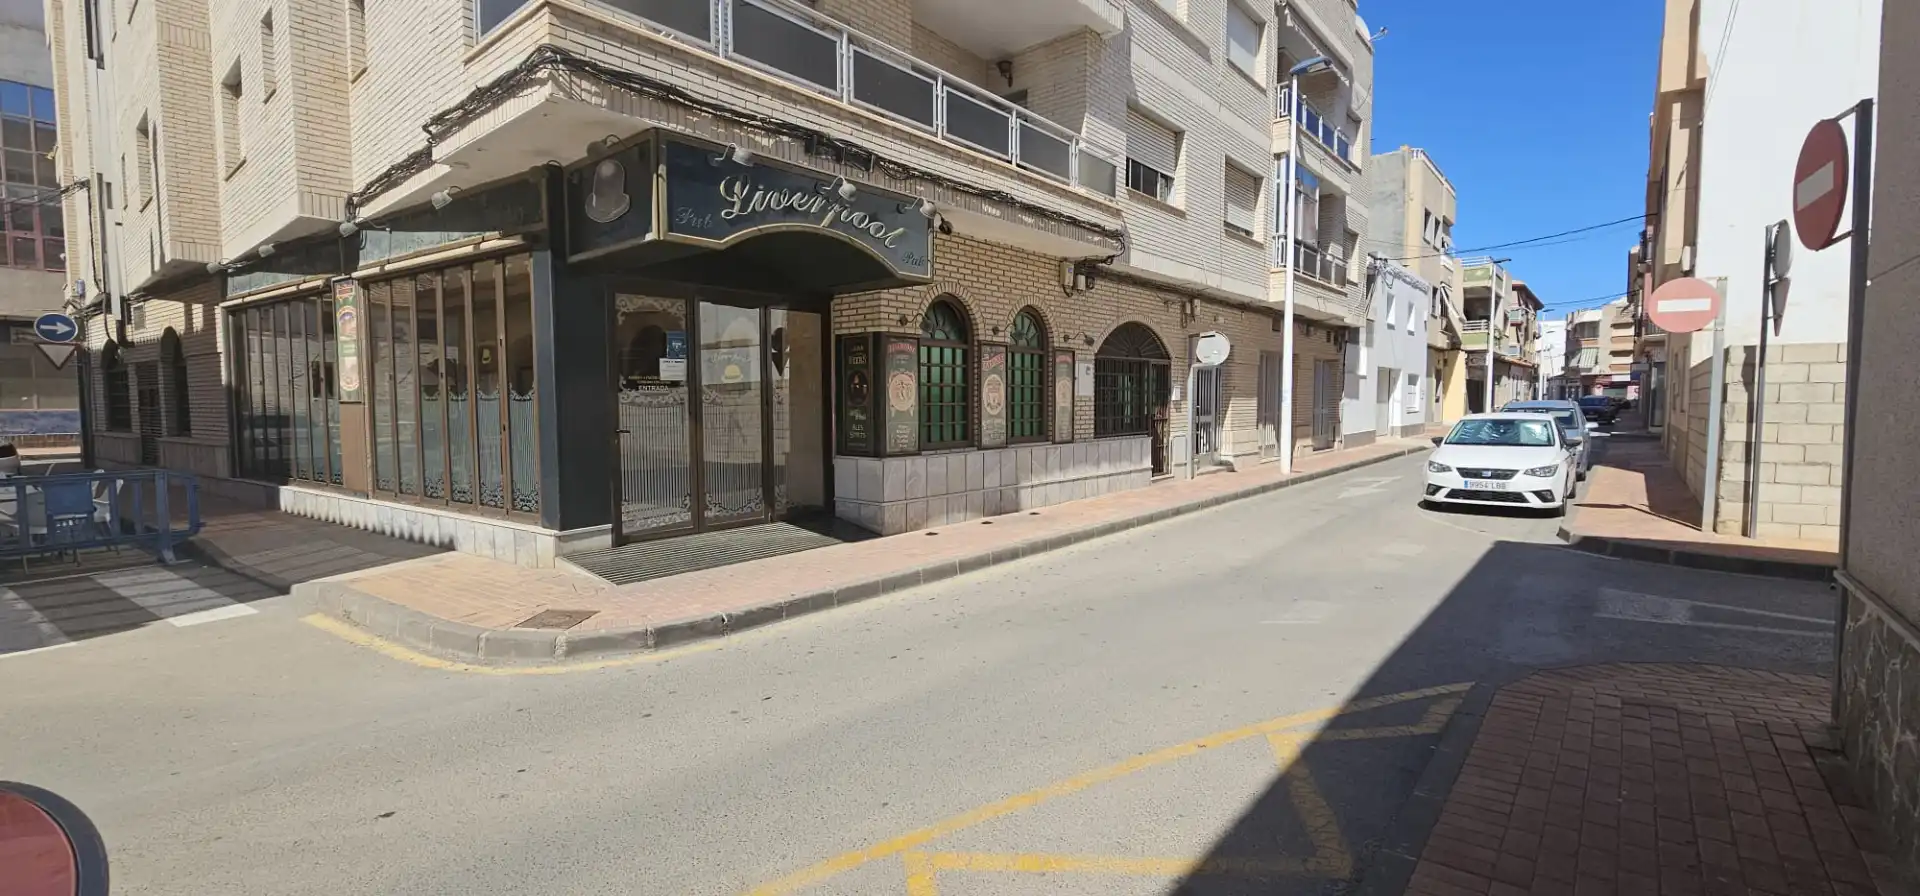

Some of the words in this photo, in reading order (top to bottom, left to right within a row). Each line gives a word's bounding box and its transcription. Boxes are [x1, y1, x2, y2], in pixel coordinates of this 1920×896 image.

[676, 207, 713, 229] Pub
[720, 175, 906, 249] Liverpool
[902, 251, 925, 268] Pub
[638, 385, 669, 393] ENTRADA
